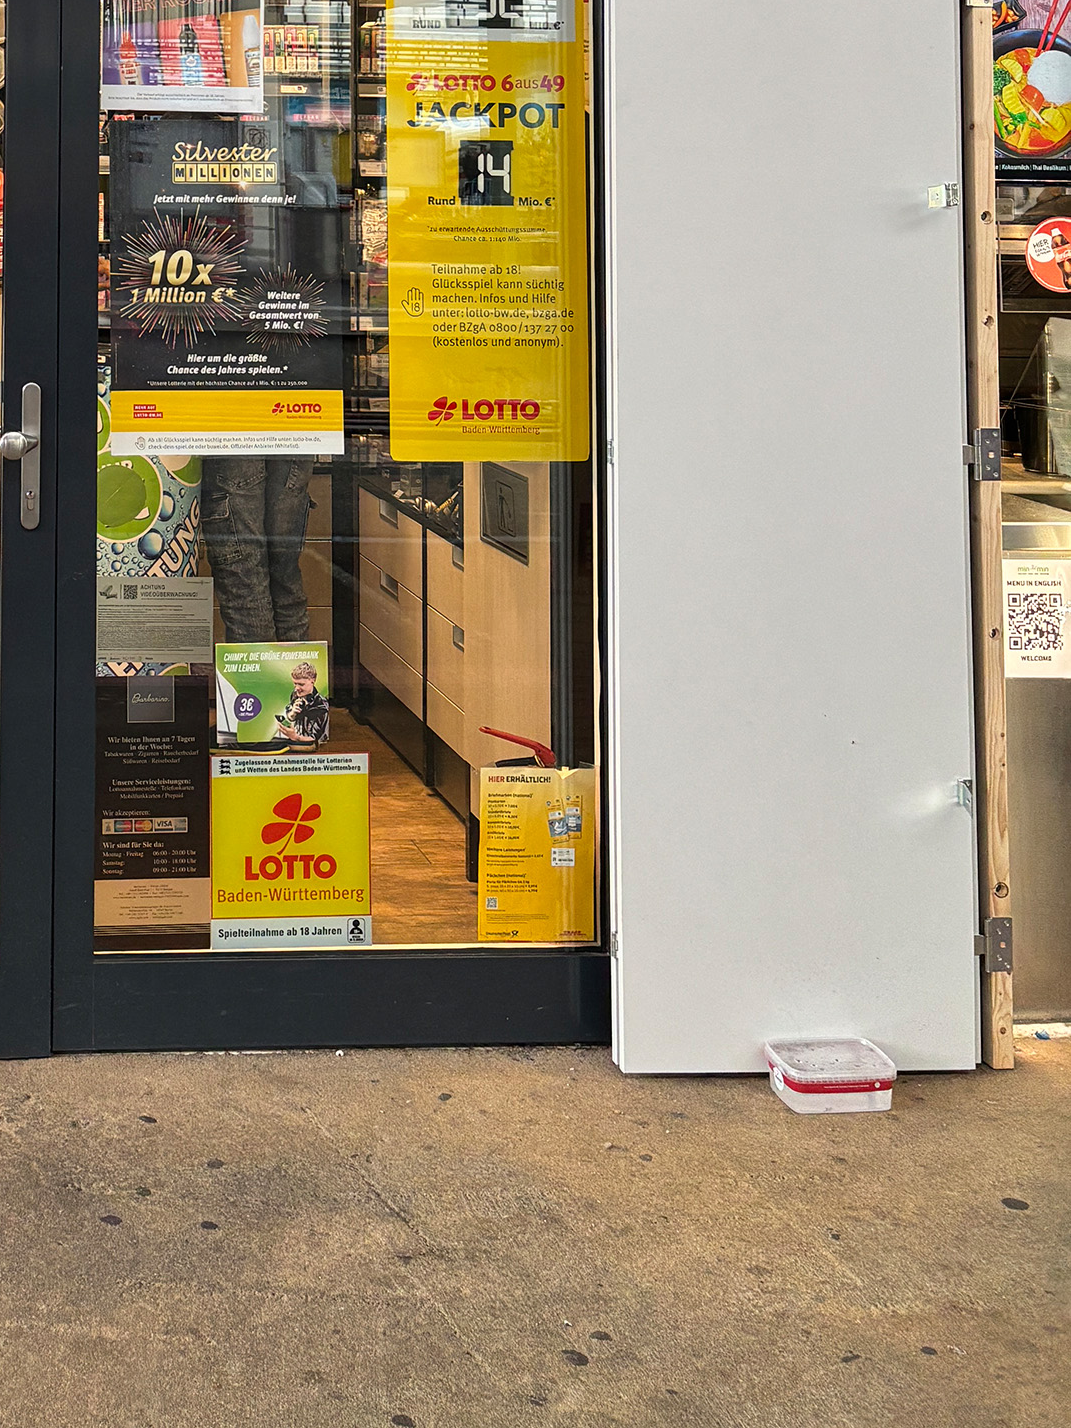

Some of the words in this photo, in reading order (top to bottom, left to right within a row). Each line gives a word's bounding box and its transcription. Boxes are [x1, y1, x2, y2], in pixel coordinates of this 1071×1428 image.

[434, 74, 496, 92] LOTTO
[407, 102, 565, 129] JACKPOT
[172, 141, 278, 162] Silvester
[175, 165, 274, 180] MILLIONEN
[478, 153, 510, 194] 14
[154, 194, 174, 204] Jetzt
[175, 195, 190, 204] mit
[192, 195, 214, 203] mehr
[216, 195, 260, 203] Gewinnen
[261, 195, 283, 203] denn
[284, 195, 296, 205] je!
[428, 196, 456, 206] Rund
[518, 197, 542, 206] Mio.
[148, 250, 215, 286] 10x
[432, 264, 486, 275] Teilnahme
[489, 265, 502, 275] ab
[506, 265, 521, 275] 18!
[432, 279, 493, 291] Glücksspiel
[497, 279, 523, 289] kann
[526, 280, 564, 291] süchtig
[131, 288, 138, 303] 1
[144, 288, 206, 303] Million
[267, 292, 301, 300] Weitere
[432, 294, 477, 303] machen.
[479, 294, 505, 303] Infos
[509, 294, 528, 303] und
[532, 294, 556, 304] Hilfe
[258, 301, 296, 310] Gewinne
[298, 301, 310, 310] im
[249, 311, 302, 320] Gesamtwert
[432, 309, 464, 318] unter:
[466, 308, 529, 320] lotto-bw.de,
[532, 308, 574, 320] bzga.de
[271, 321, 291, 330] Mio.
[293, 321, 304, 330] €!
[433, 323, 456, 332] oder
[459, 323, 486, 334] BZgA
[544, 324, 557, 334] 27
[432, 336, 488, 348] (kostenlos
[491, 337, 511, 347] und
[514, 337, 564, 348] anonym).
[187, 354, 206, 363] Hier
[223, 354, 237, 363] die
[238, 354, 268, 365] größte
[167, 365, 198, 374] Chance
[200, 365, 215, 374] des
[217, 365, 247, 376] Jahres
[286, 403, 322, 413] LOTTO
[462, 399, 540, 420] LOTTO
[224, 653, 248, 661] CHIMPY,
[249, 652, 259, 661] DIE
[260, 651, 280, 660] GRÜNE
[281, 651, 318, 660] POWERBANK
[224, 664, 238, 672] ZUM
[239, 663, 261, 672] LEIHEN.
[239, 698, 254, 712] 3€
[303, 764, 361, 773] Baden-Württemberg
[506, 774, 551, 783] ERHÄLTLICH!
[245, 854, 337, 881] LOTTO
[217, 887, 365, 904] Baden-Württemberg
[218, 928, 284, 939] Spielteilnahme
[287, 928, 298, 936] ab
[300, 927, 310, 936] 18
[312, 926, 342, 936] Jahren
